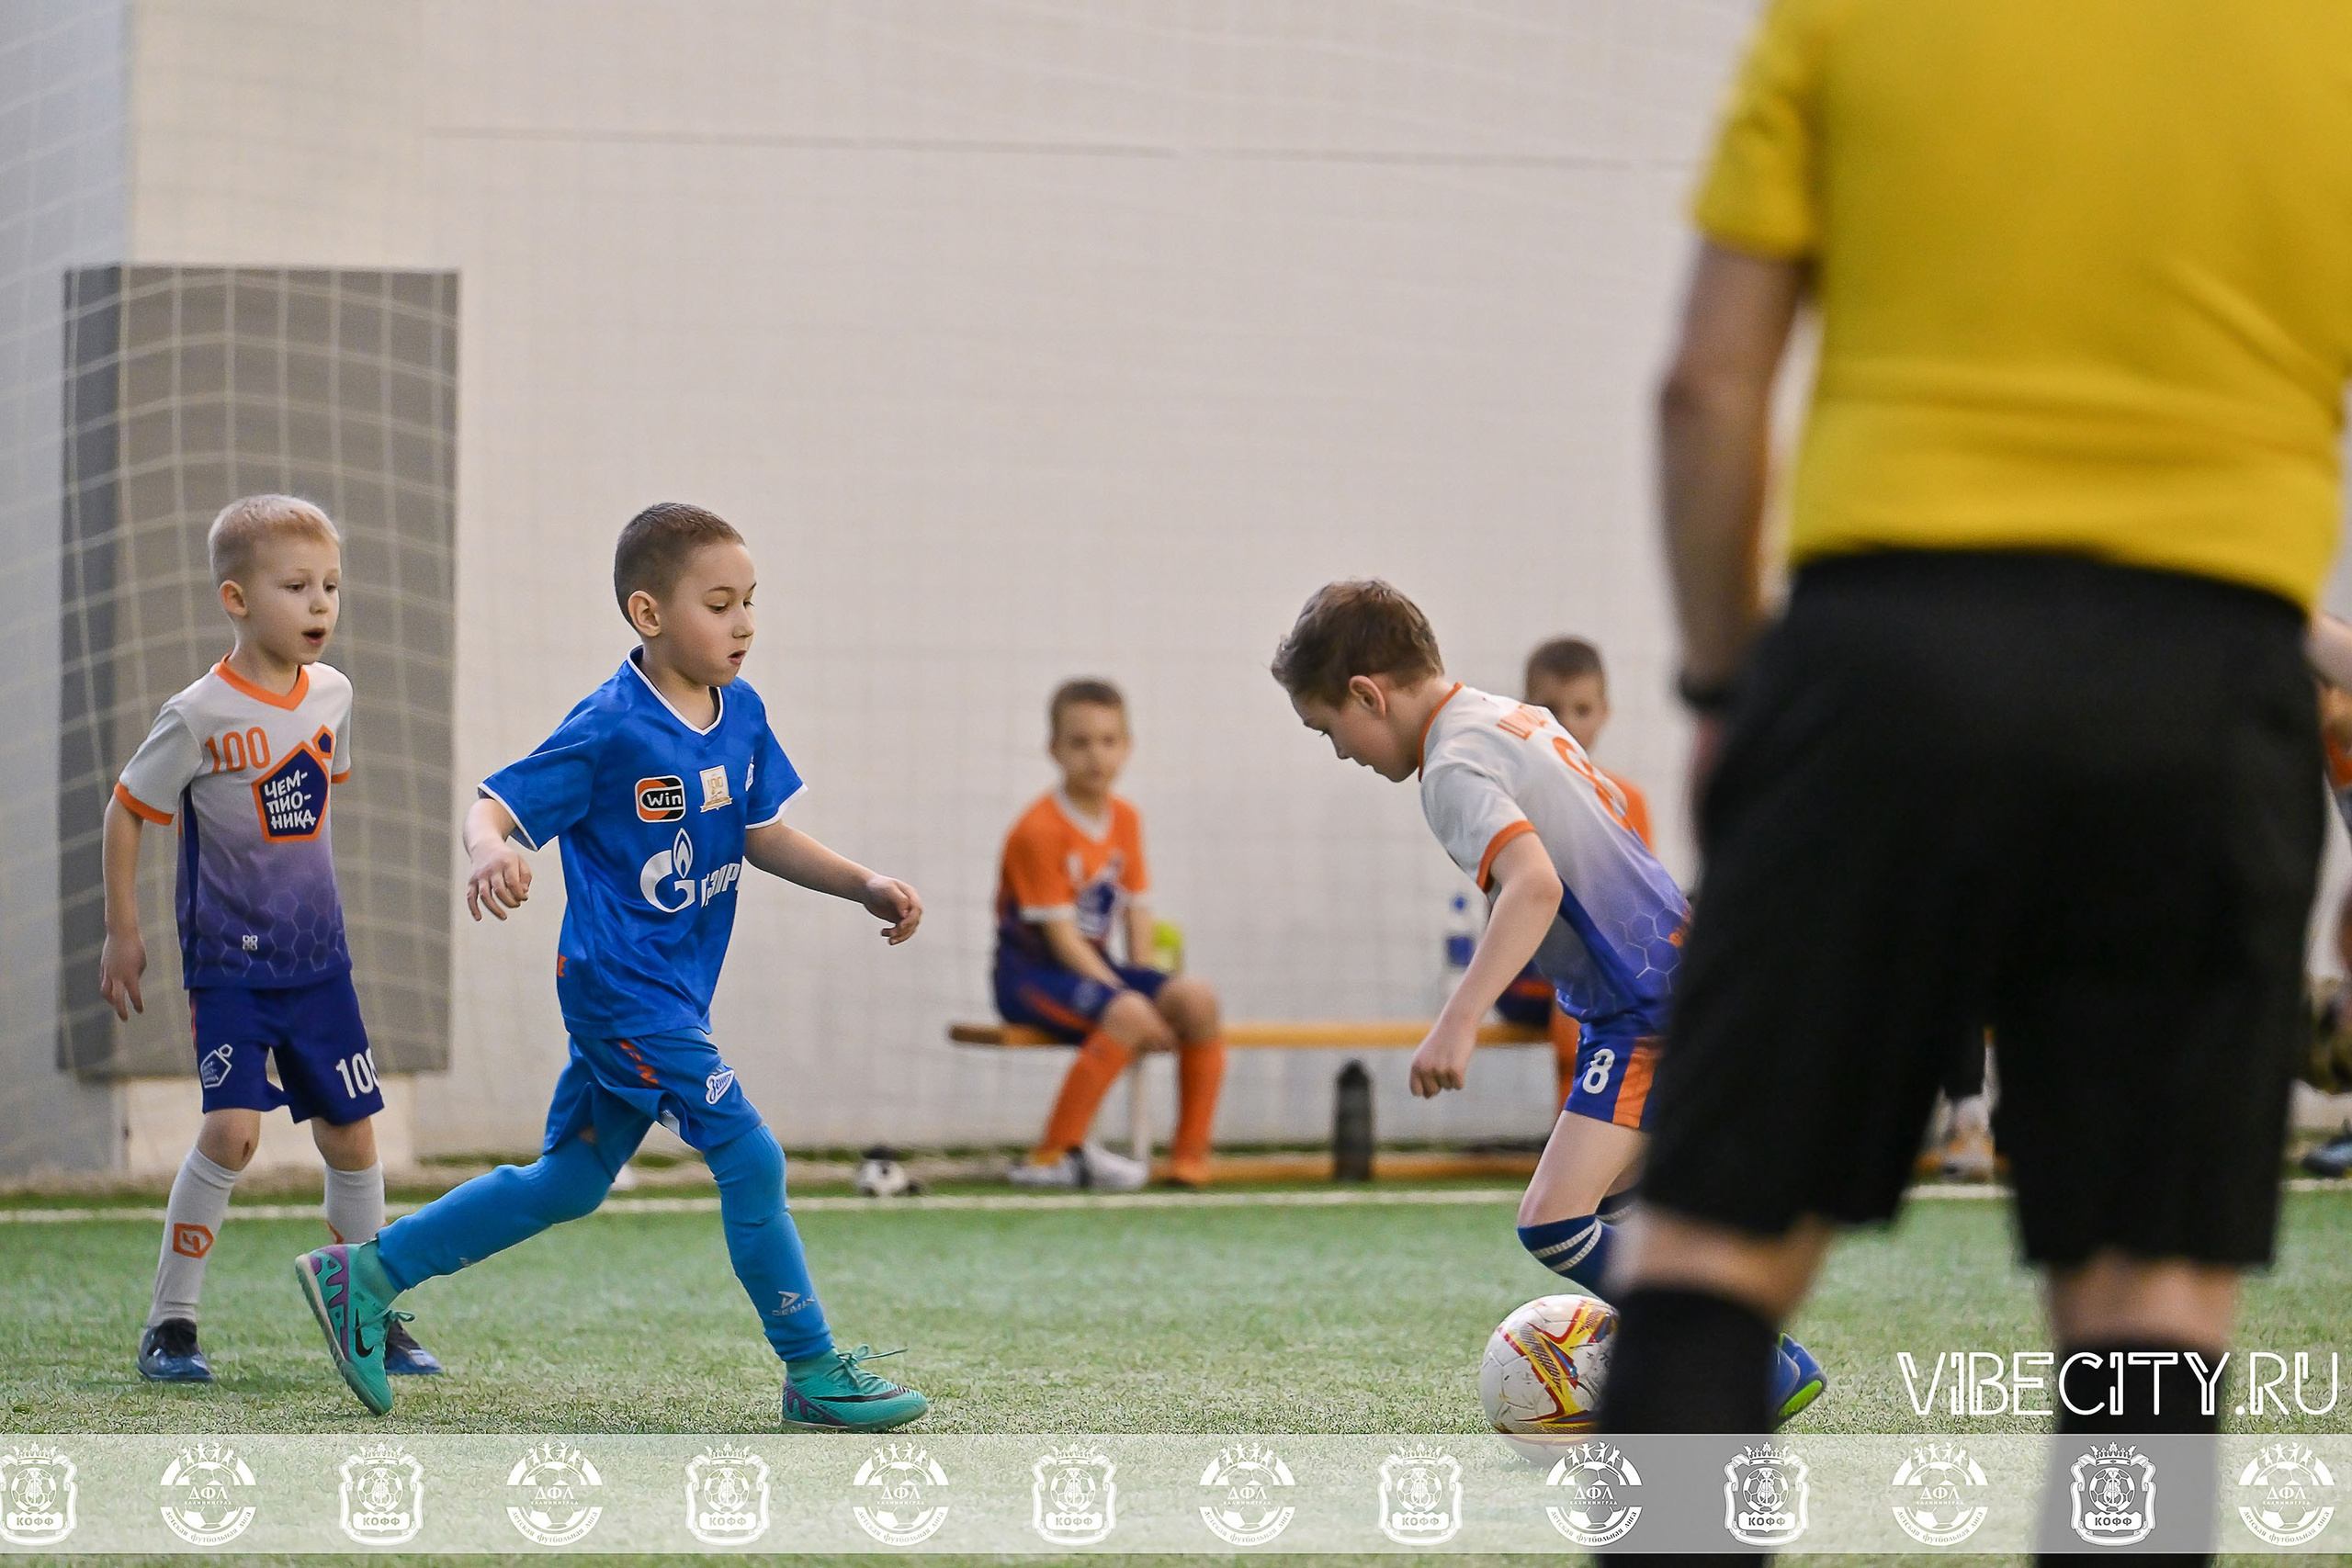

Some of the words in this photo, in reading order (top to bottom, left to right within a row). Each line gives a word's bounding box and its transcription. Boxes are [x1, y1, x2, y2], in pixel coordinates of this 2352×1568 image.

[205, 727, 270, 773] 100
[265, 770, 308, 798] ЧЕМ-
[267, 791, 311, 814] ПИО-
[647, 793, 682, 806] Win
[271, 809, 316, 829] НИКА
[1583, 1048, 1615, 1094] 8
